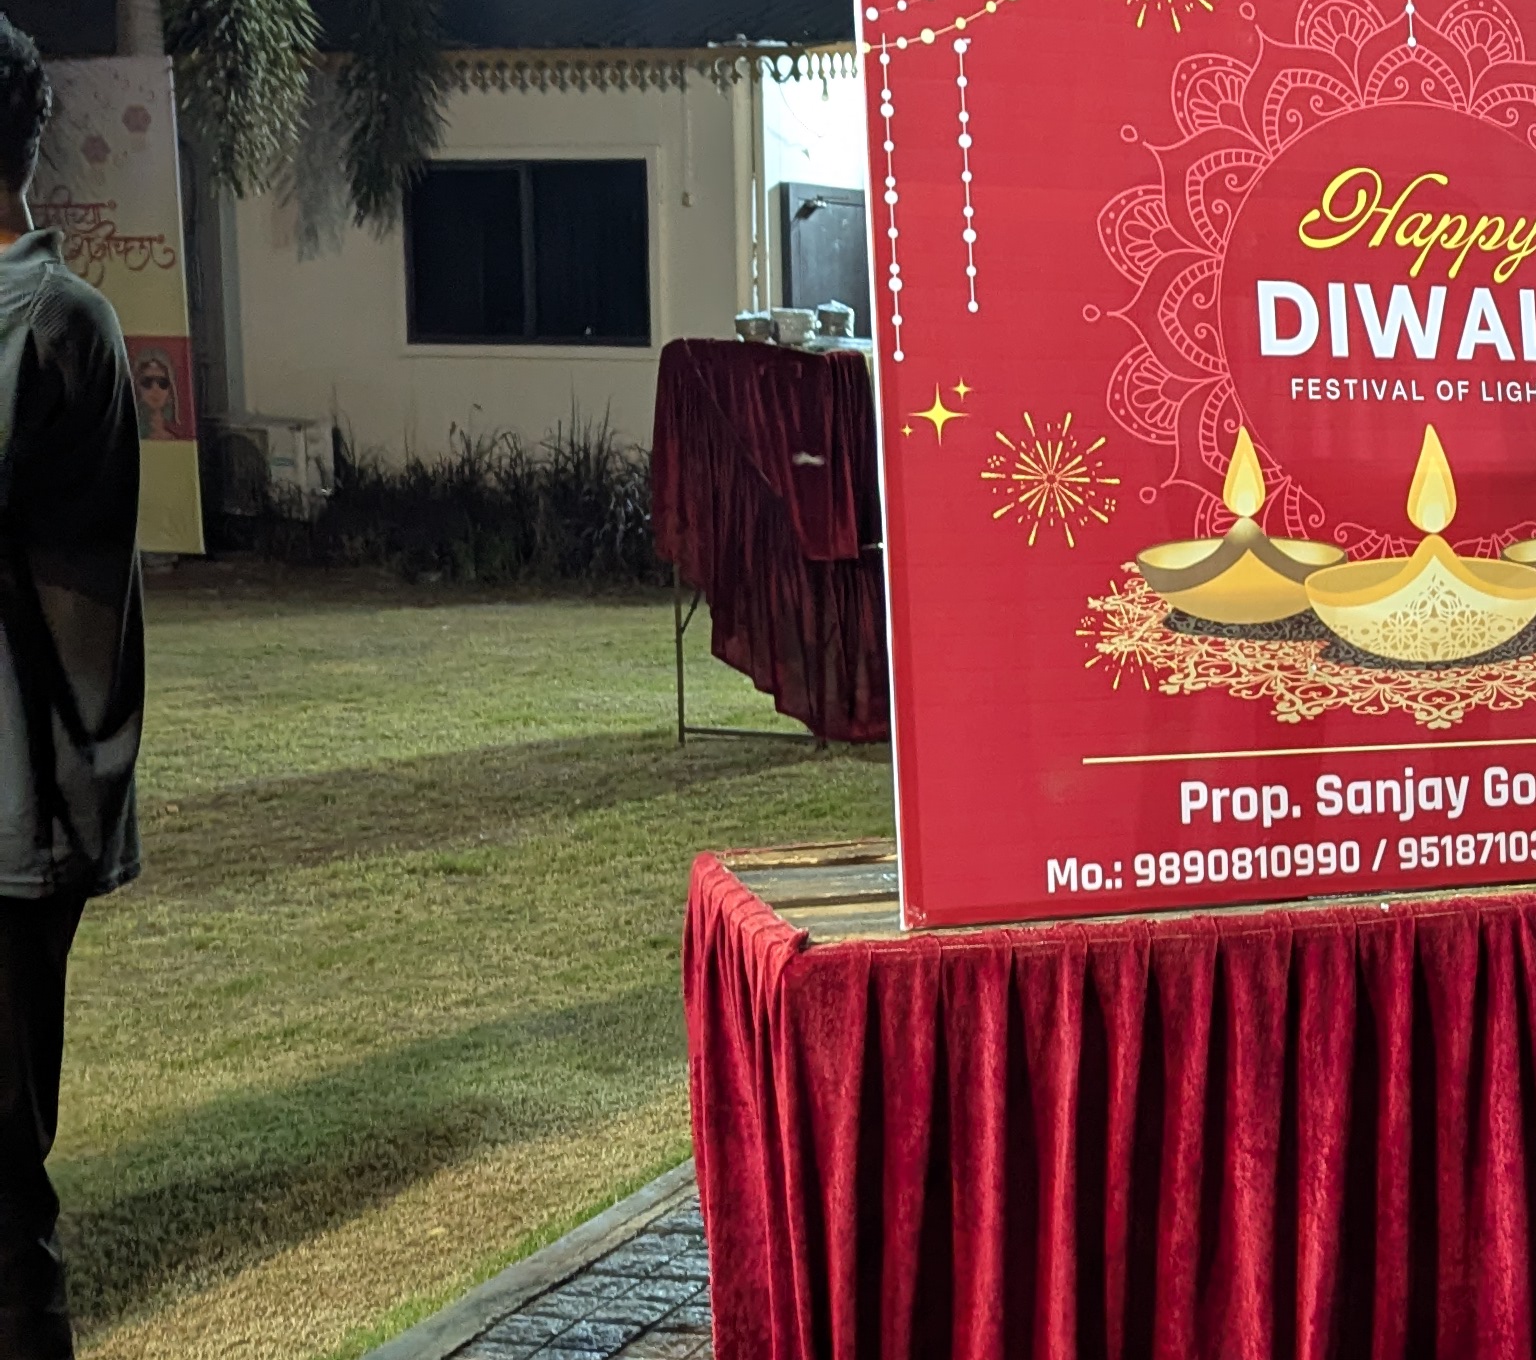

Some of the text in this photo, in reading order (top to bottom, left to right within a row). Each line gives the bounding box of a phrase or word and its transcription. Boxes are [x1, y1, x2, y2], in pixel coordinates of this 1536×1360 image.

[1291, 377, 1425, 401] FESTIVAL
[1436, 379, 1470, 402] OF
[1179, 780, 1302, 828] Prop.
[1315, 766, 1469, 822] Sanjay
[1046, 857, 1123, 894] Mo.:
[1133, 840, 1361, 888] 9890810990
[1371, 838, 1388, 872] /
